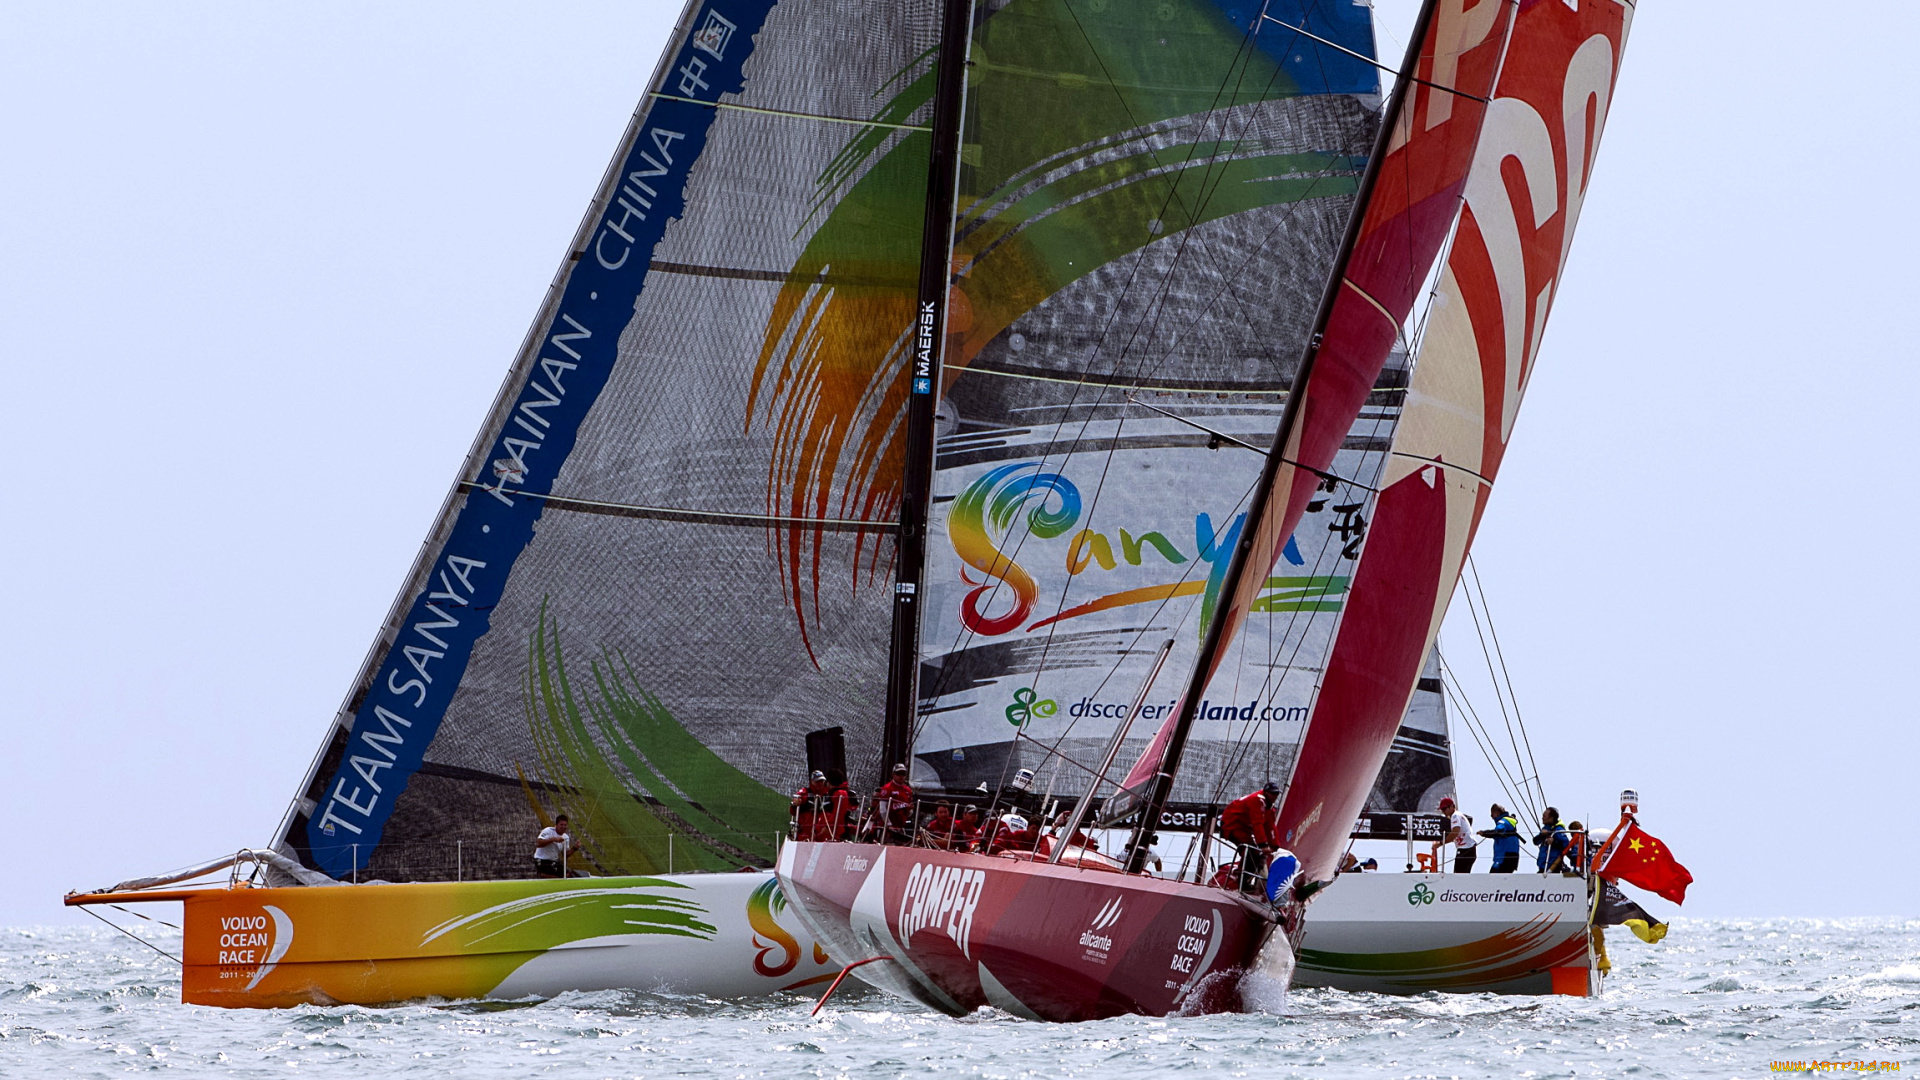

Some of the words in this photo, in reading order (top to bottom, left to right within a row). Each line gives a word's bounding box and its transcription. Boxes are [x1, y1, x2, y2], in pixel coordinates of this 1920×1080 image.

[917, 301, 935, 376] MAERSK
[319, 704, 413, 834] TEAM
[388, 555, 487, 708] SANYA
[481, 313, 592, 507] HAINAN
[595, 127, 685, 271] CHINA
[946, 462, 1305, 650] Sany
[1439, 889, 1575, 903] discoverireland.com
[899, 862, 986, 961] CAMPER
[221, 916, 267, 931] VOLVO
[1184, 914, 1210, 935] VOLVO
[220, 933, 267, 947] OCEAN
[1079, 929, 1112, 951] alicante
[1177, 934, 1206, 955] OCEAN
[219, 950, 255, 964] RACE
[1170, 954, 1193, 973] RACE
